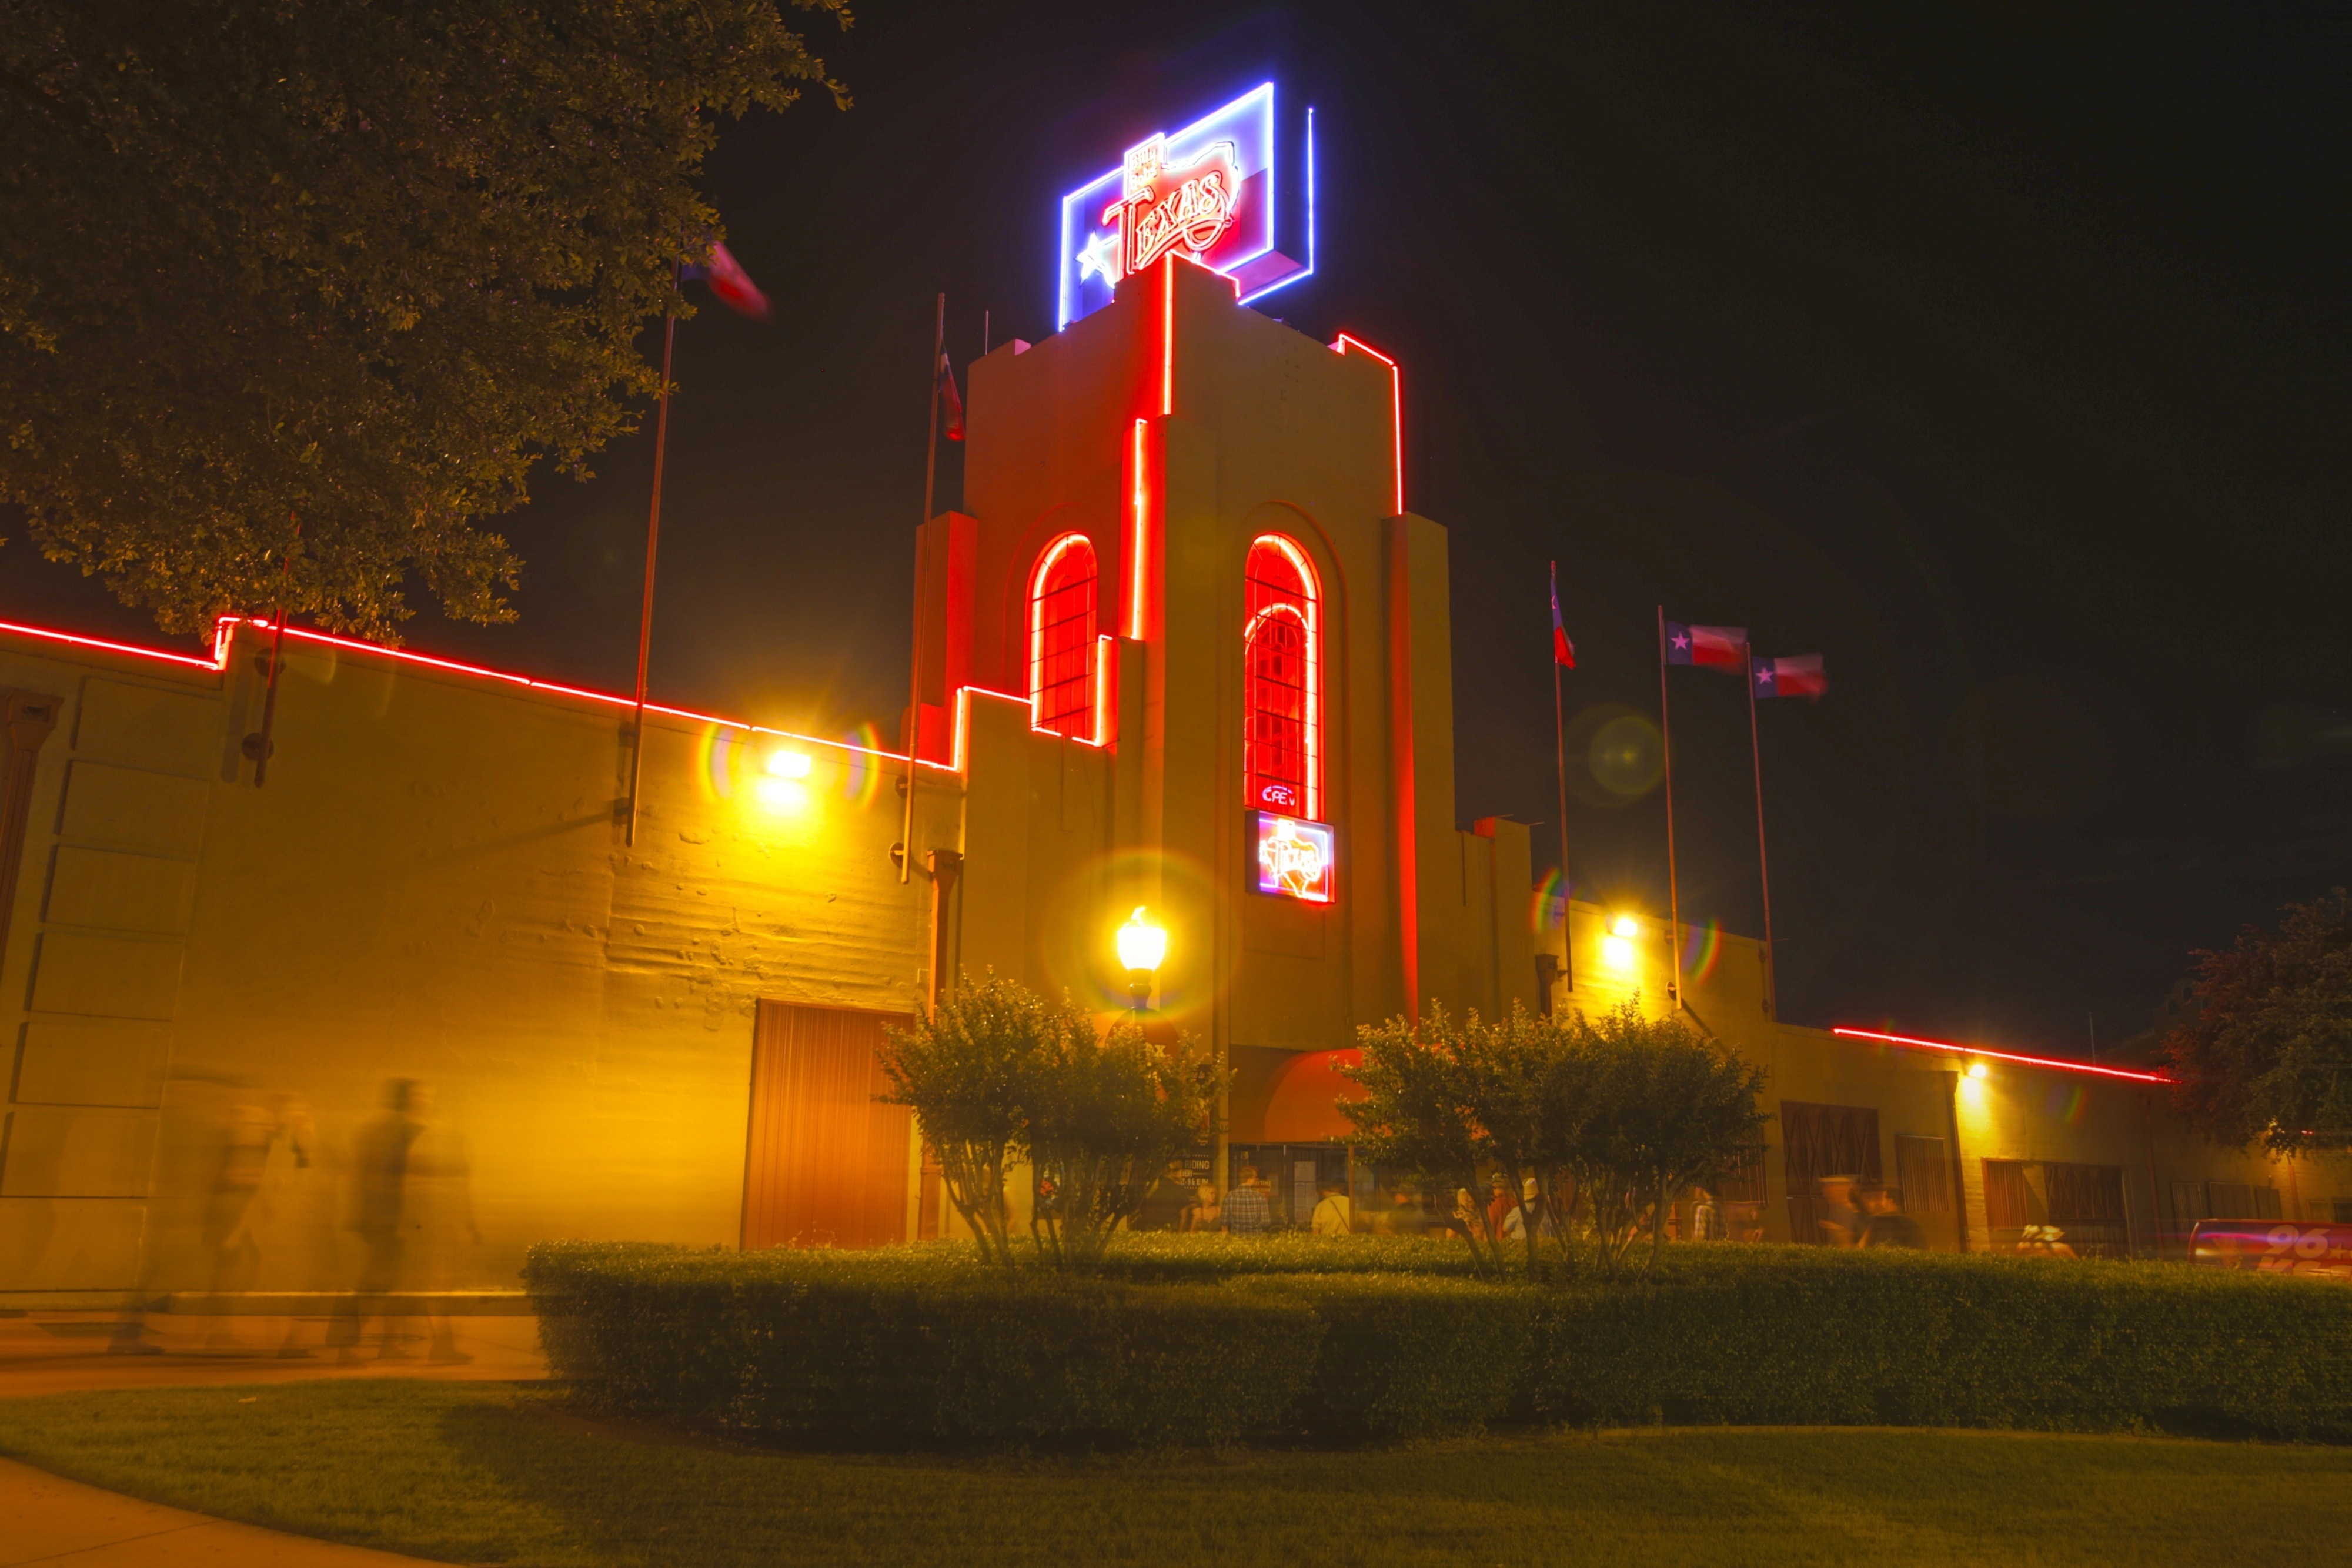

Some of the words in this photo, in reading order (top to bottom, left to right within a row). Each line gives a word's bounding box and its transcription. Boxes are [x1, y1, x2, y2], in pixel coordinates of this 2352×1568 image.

[1130, 148, 1158, 171] Billy
[1184, 1159, 1210, 1170] RIDING
[2263, 1224, 2331, 1259] 96
